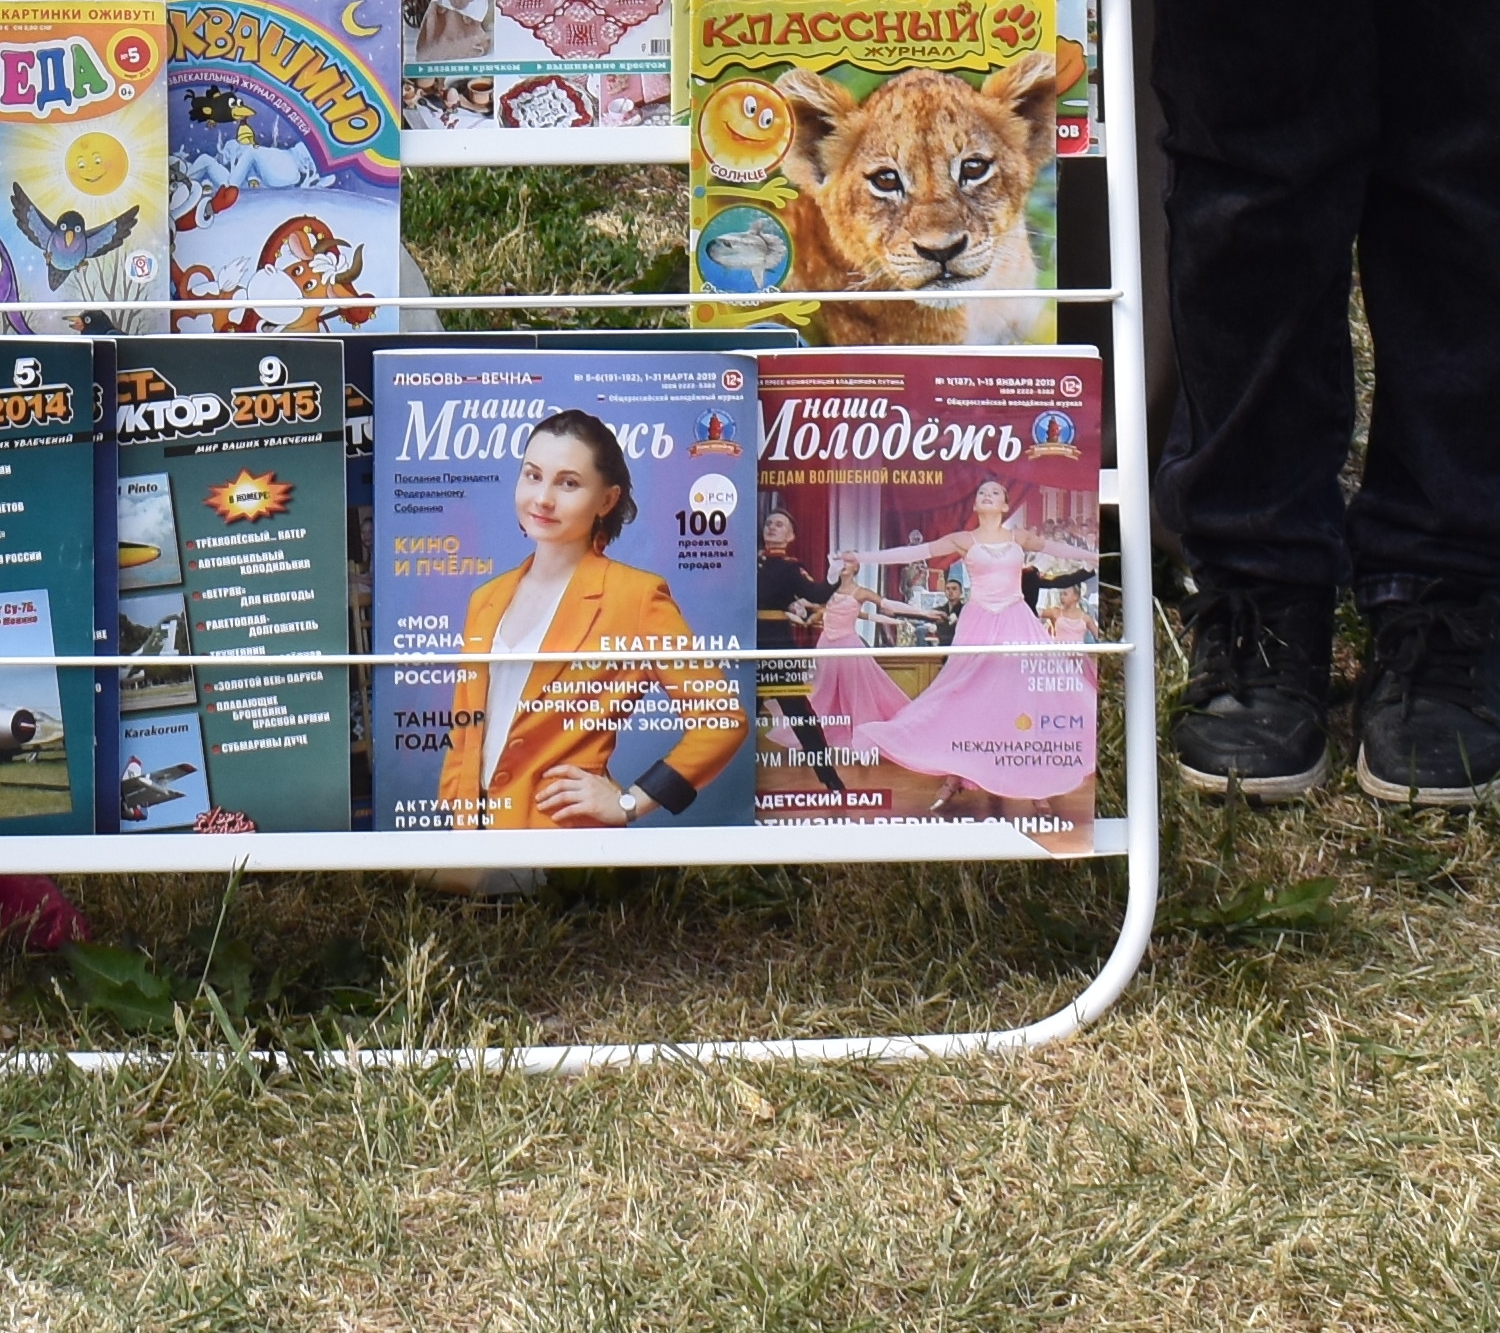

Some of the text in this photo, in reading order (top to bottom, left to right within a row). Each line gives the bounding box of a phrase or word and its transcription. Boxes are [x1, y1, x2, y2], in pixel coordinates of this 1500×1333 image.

[1, 8, 81, 20] КАРТИНКИ
[88, 8, 156, 21] ОЖИВУТ!
[703, 1, 981, 48] КЛАССНЫЙ
[864, 45, 956, 57] ЖУРНАЛ
[711, 163, 767, 182] СОЛНЦЕ
[13, 358, 38, 386] 5
[259, 356, 283, 385] 9
[394, 372, 533, 385] ЛЮБОВЬ ВЕЧНА
[232, 393, 315, 423] 2015
[462, 398, 545, 418] наша
[803, 397, 888, 419] наша
[758, 399, 1022, 462] Молодёжь
[13, 433, 74, 450] УВЛЕЧЕНИЙ
[195, 434, 323, 454] МИР ВАШИХ УВЛЕЧЕНИЙ
[394, 473, 499, 483] Послание Президента
[758, 466, 943, 487] ЛЕДАМ ВОЛШЕБНОЙ СКАЗКИ
[127, 482, 159, 495] Pinto
[394, 488, 466, 499] Федеральному
[394, 504, 444, 513] Собранию
[674, 510, 727, 536] 100
[394, 535, 461, 554] КИНО
[678, 539, 729, 548] проектов
[678, 550, 734, 559] для малых
[394, 553, 493, 576] И ПЧЁЛЫ
[678, 561, 722, 570] городов
[397, 615, 449, 630] «МОЯ
[393, 634, 465, 648] СТРАНА
[601, 636, 741, 651] ЕКАТЕРИНА
[1020, 660, 1083, 674] РУССКИХ
[394, 669, 478, 685] РОССИЯ»
[1028, 677, 1083, 692] ЗЕМЕЛЬ
[541, 680, 740, 695] «ВИЛЮЧИНСК ГОРОД
[517, 698, 740, 714] МОРЯКОВ, ПОДВОДНИКОВ
[394, 711, 486, 728] ТАНЦОР
[563, 716, 740, 731] И ЮНЫХ ЭКОЛОГОВ»
[1040, 715, 1083, 729] РСМ
[124, 721, 190, 739] Karakorum
[395, 733, 454, 750] ГОДА
[952, 740, 1083, 754] МЕЖДУНАРОДНЫЕ
[995, 753, 1083, 767] ИТОГИ ГОДА
[395, 798, 513, 813] АКТУАЛЬНЫЕ
[395, 813, 495, 828] ПРОБЛЕМЫ
